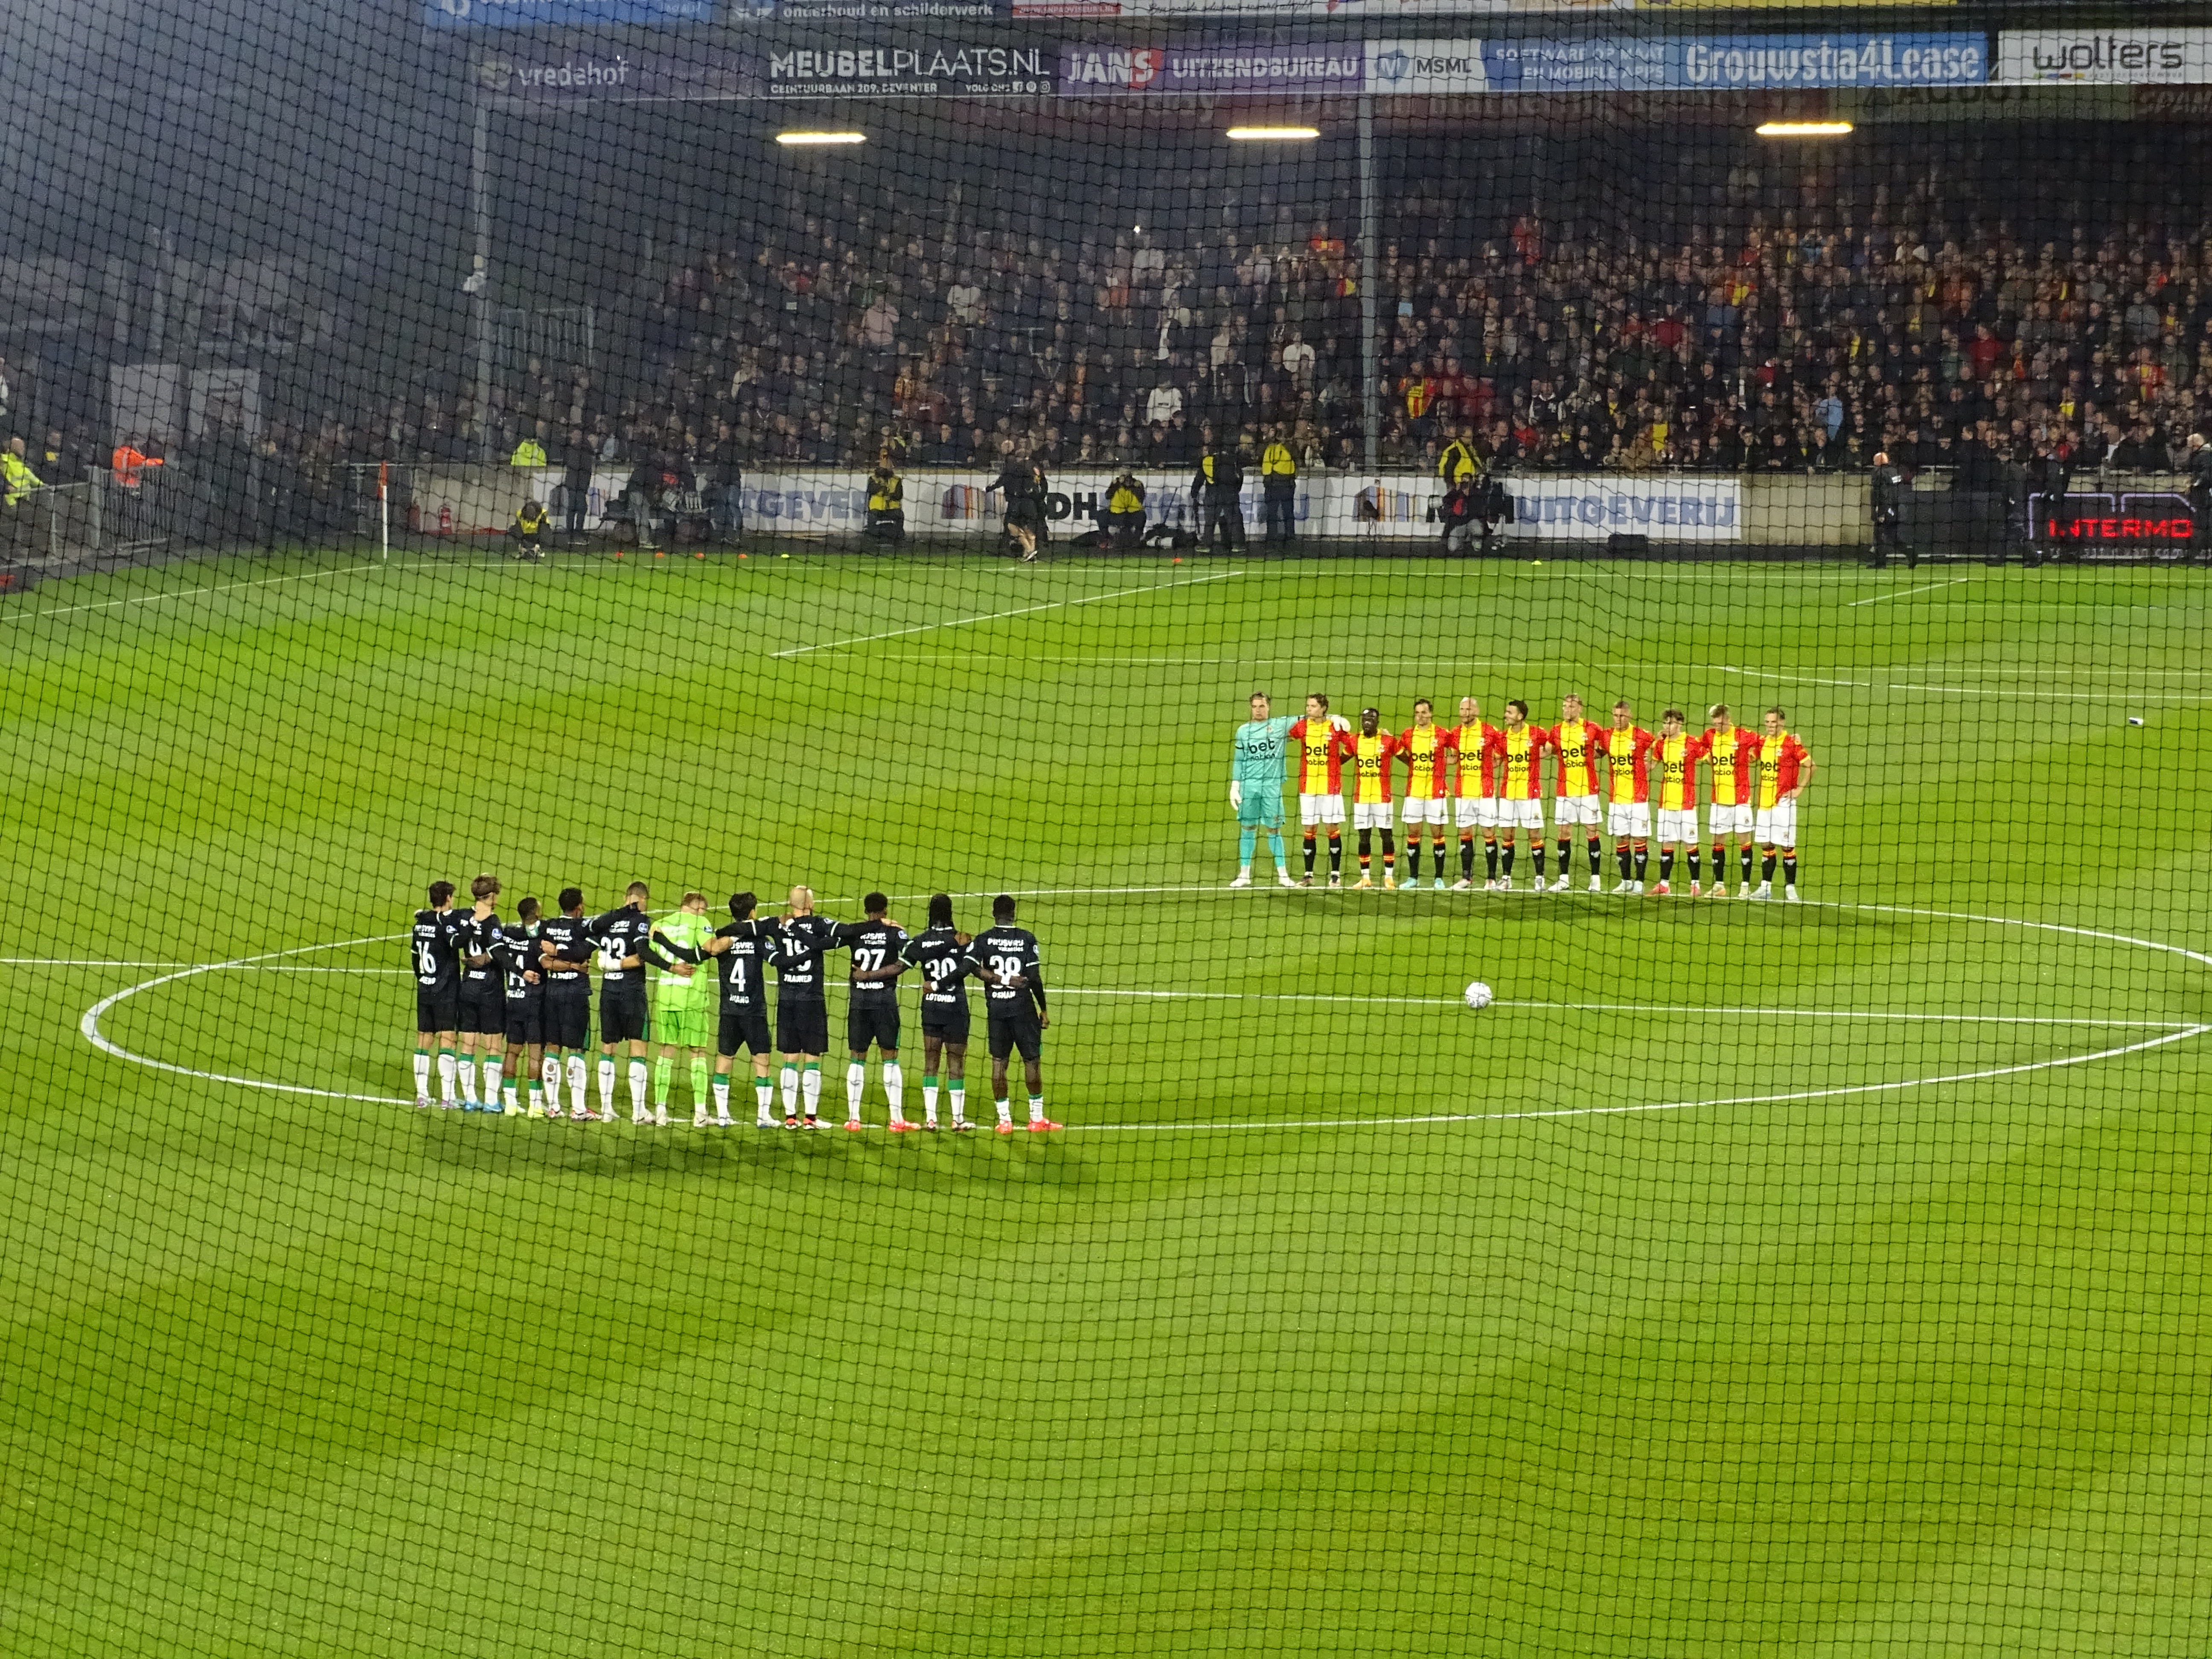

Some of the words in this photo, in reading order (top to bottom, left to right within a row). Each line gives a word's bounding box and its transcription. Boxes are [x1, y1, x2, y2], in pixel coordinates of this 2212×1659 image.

[783, 3, 866, 17] onderhoud
[871, 5, 890, 16] en
[894, 2, 993, 16] schilderwerk
[1496, 48, 1584, 61] SOFTWARE
[1595, 47, 1615, 59] OP
[1621, 47, 1665, 60] MAAT
[1686, 39, 1979, 82] Grouwsta4Lease
[2033, 35, 2183, 70] wolters
[770, 48, 1051, 78] MEUBELPLAATS.NL
[1067, 52, 1155, 84] JANS
[1172, 56, 1358, 79] UITZENDBUREAU
[1417, 58, 1472, 73] MSML
[518, 60, 629, 86] vredehof
[1524, 67, 1543, 80] EN
[1549, 67, 1617, 80] MOBIELE
[1621, 66, 1665, 79] APPS
[771, 83, 855, 94] CEINTUURBAAN
[882, 82, 938, 93] DEVENTER
[966, 82, 989, 92] VOLG
[1516, 496, 1734, 525] UITGEVERIJ
[1247, 738, 1275, 754] bet
[729, 958, 746, 992] 4
[926, 993, 956, 1003] LOTOMBA
[992, 990, 1016, 999] OSMAN
